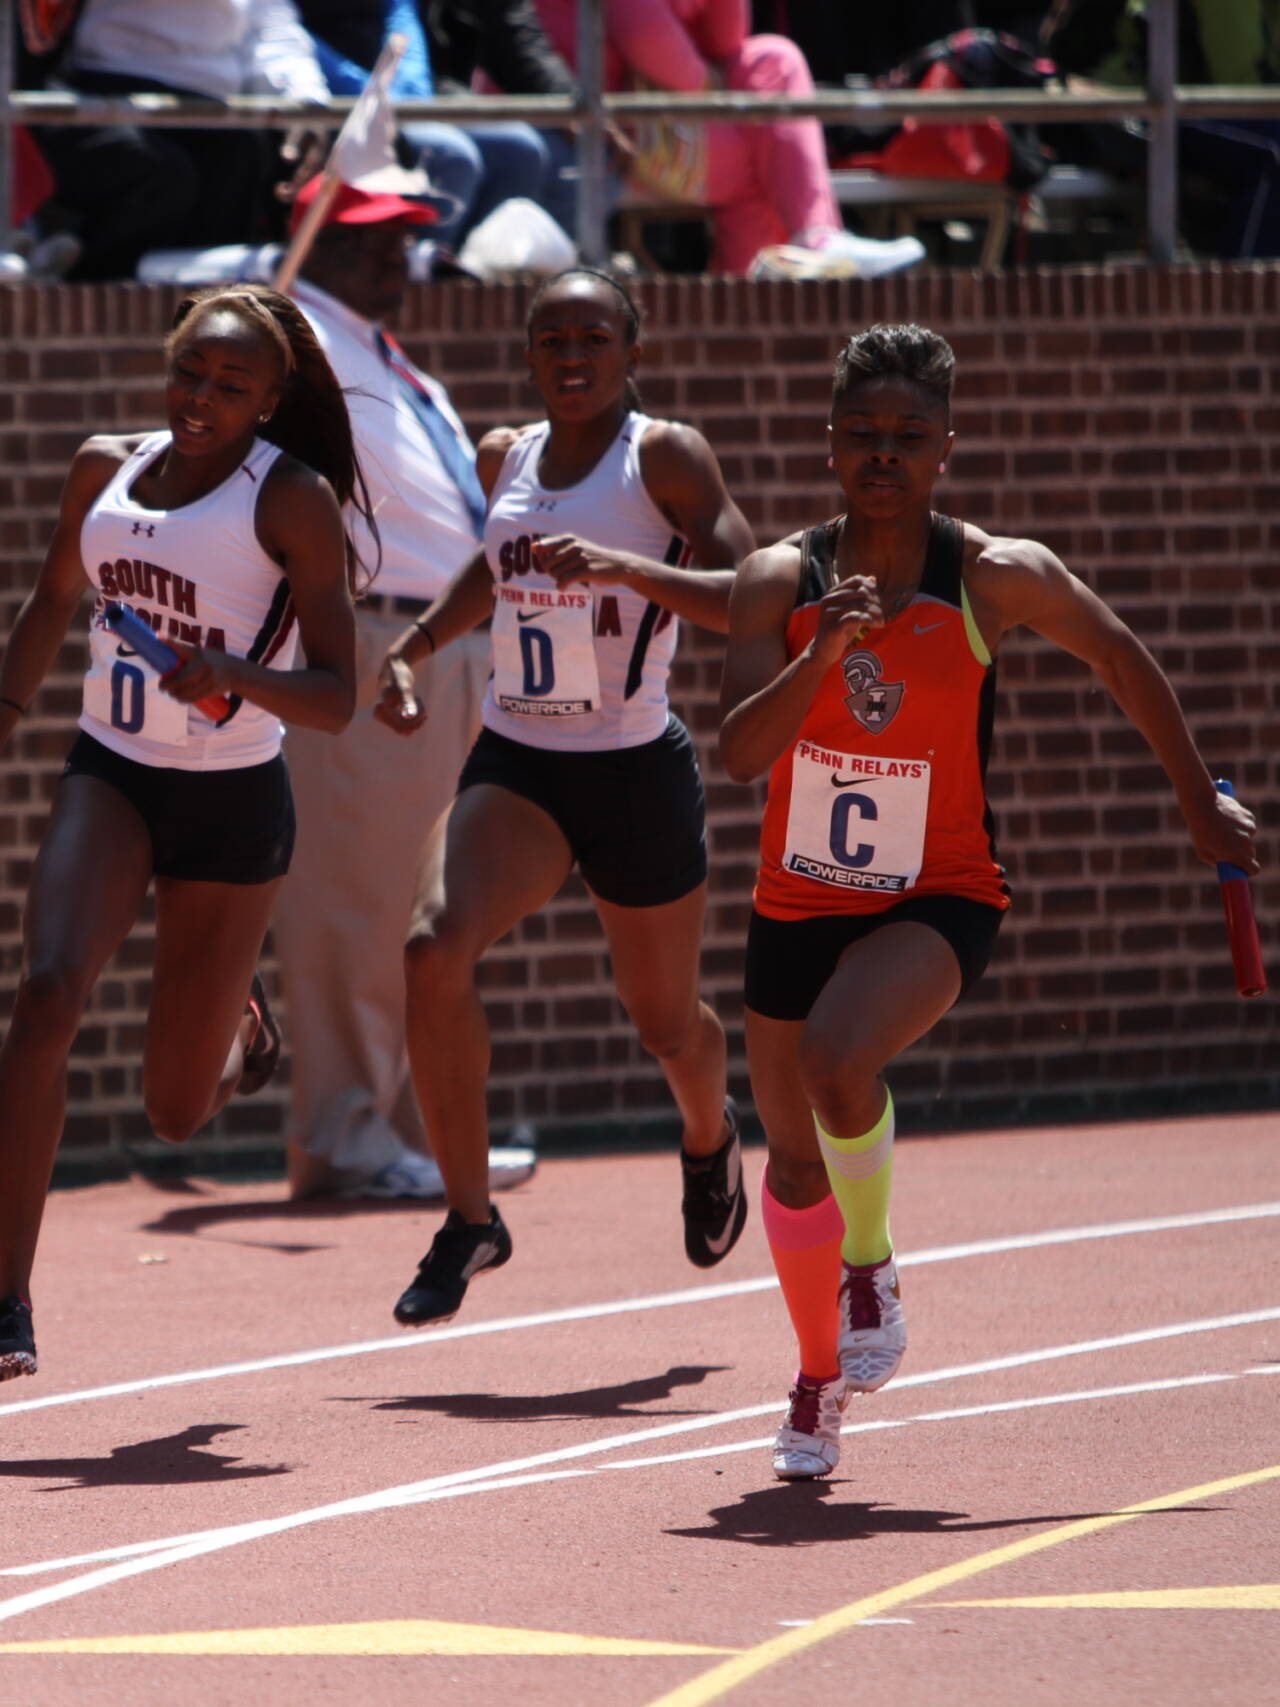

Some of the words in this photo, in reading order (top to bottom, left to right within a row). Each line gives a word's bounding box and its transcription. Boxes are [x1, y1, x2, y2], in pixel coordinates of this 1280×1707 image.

[98, 558, 197, 619] SOUTH
[500, 588, 524, 604] PENN
[530, 592, 587, 608] RELAYS
[519, 627, 555, 697] D
[502, 698, 586, 716] POWERADE
[799, 743, 843, 769] PENN
[851, 758, 922, 778] RELAYS
[829, 792, 878, 868] C
[793, 857, 902, 889] POWERADE
